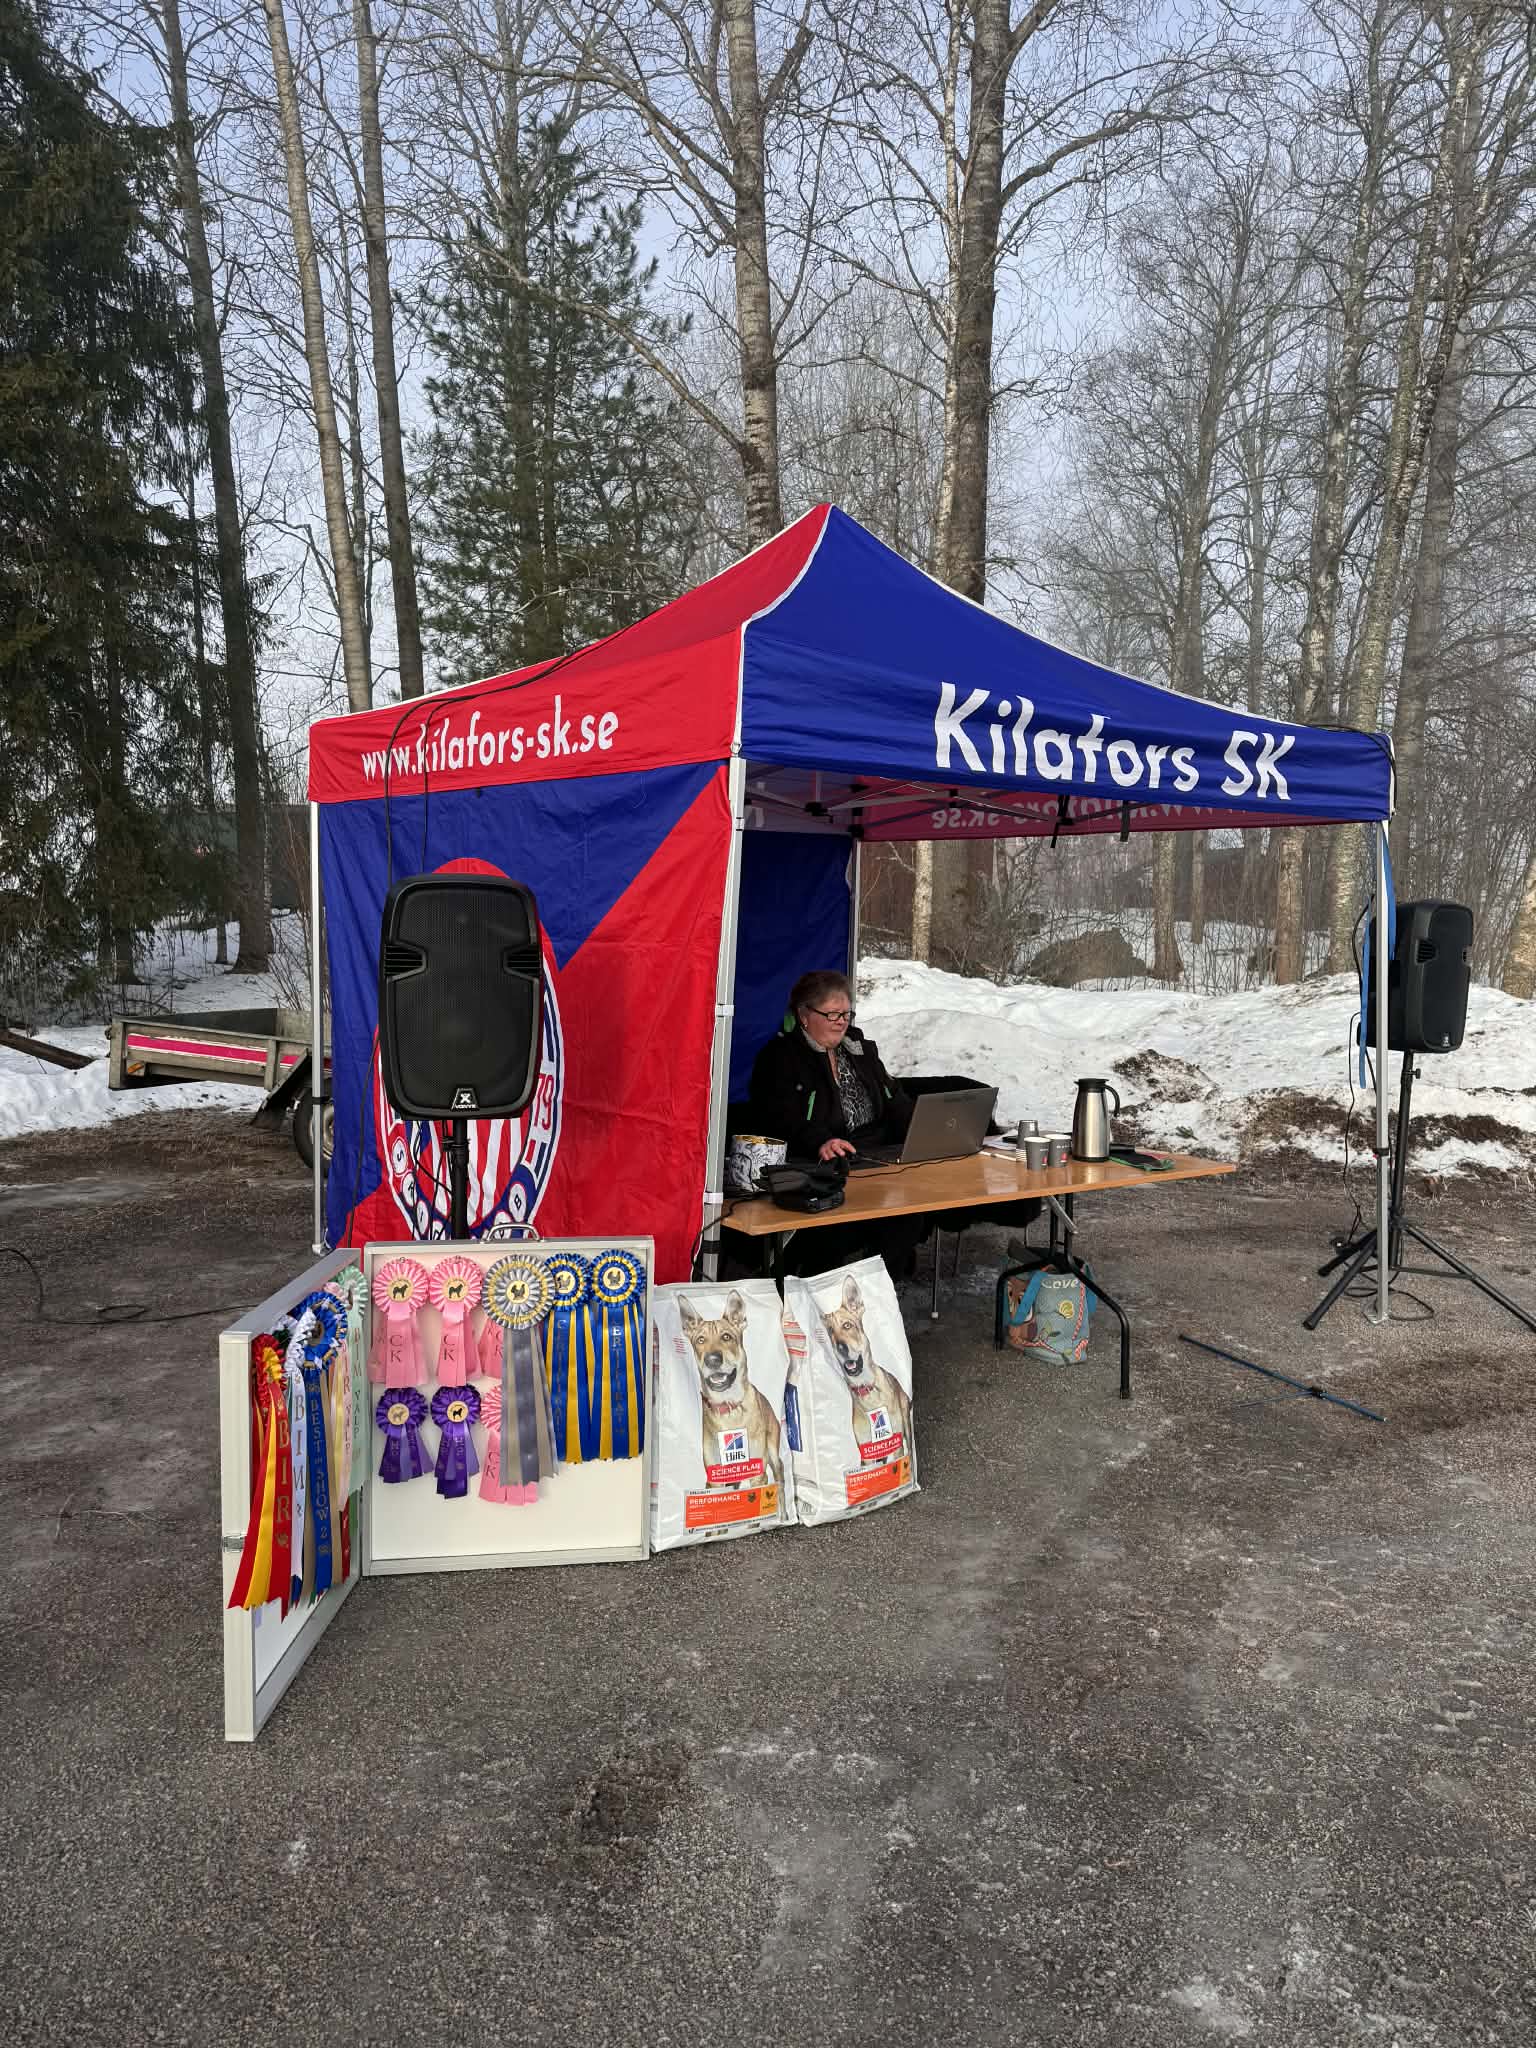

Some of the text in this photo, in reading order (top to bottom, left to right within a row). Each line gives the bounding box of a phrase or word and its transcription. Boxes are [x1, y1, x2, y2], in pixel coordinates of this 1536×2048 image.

[361, 695, 619, 782] www.kilafors-sk.se
[934, 681, 1296, 800] Kilafors SK
[389, 1334, 403, 1363] CK
[443, 1333, 456, 1361] CK
[276, 1419, 291, 1524] BIR
[711, 1466, 741, 1477] SCIENCE
[742, 1462, 761, 1473] PLAN
[689, 1494, 741, 1505] PERFORMANCE
